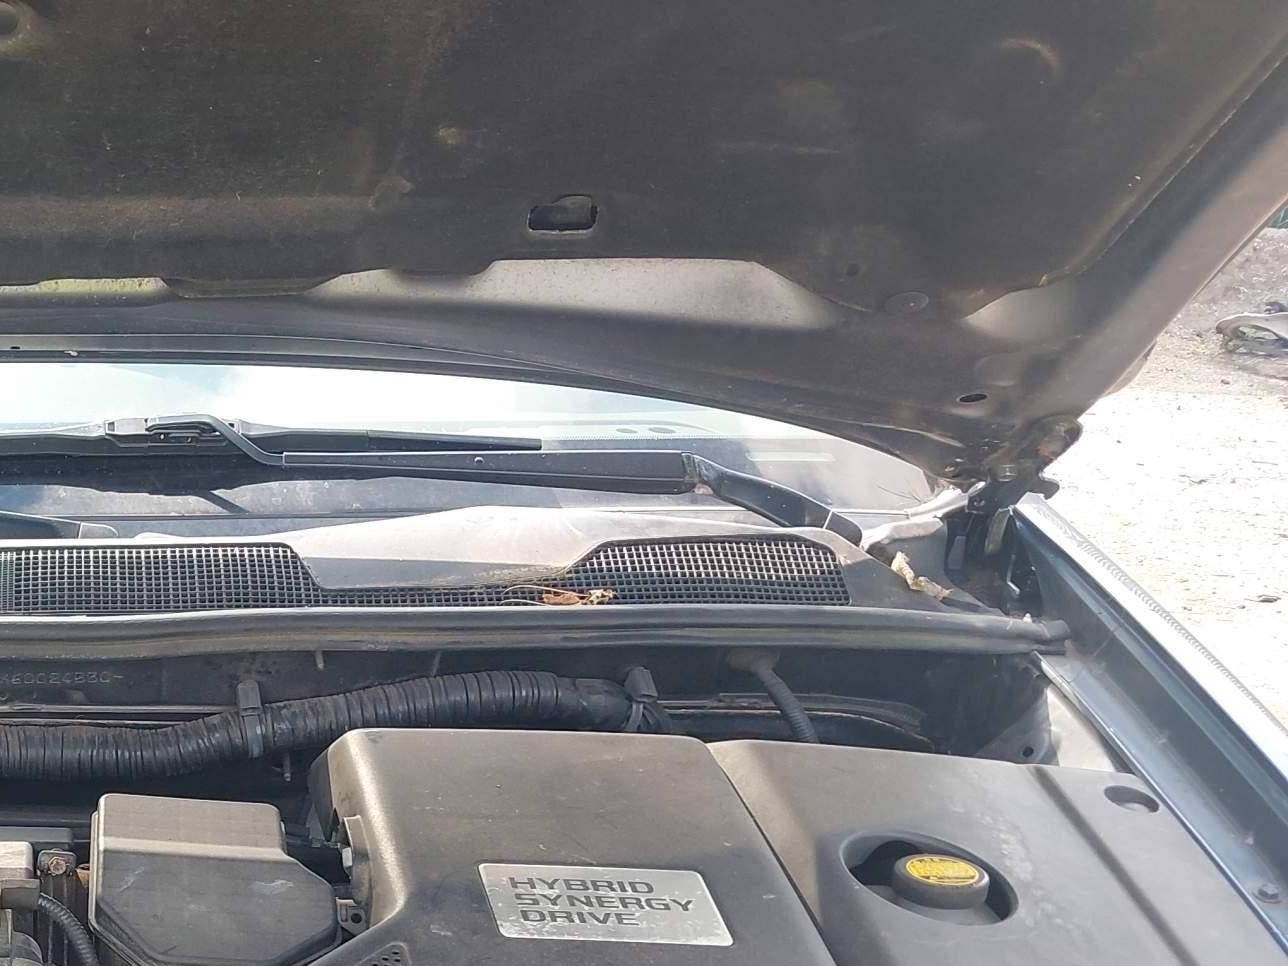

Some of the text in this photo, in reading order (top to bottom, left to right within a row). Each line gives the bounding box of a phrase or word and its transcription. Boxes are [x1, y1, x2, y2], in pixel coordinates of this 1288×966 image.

[508, 877, 654, 894] HYBRID
[514, 893, 694, 912] SYNERGY
[520, 909, 640, 926] DRIVE
